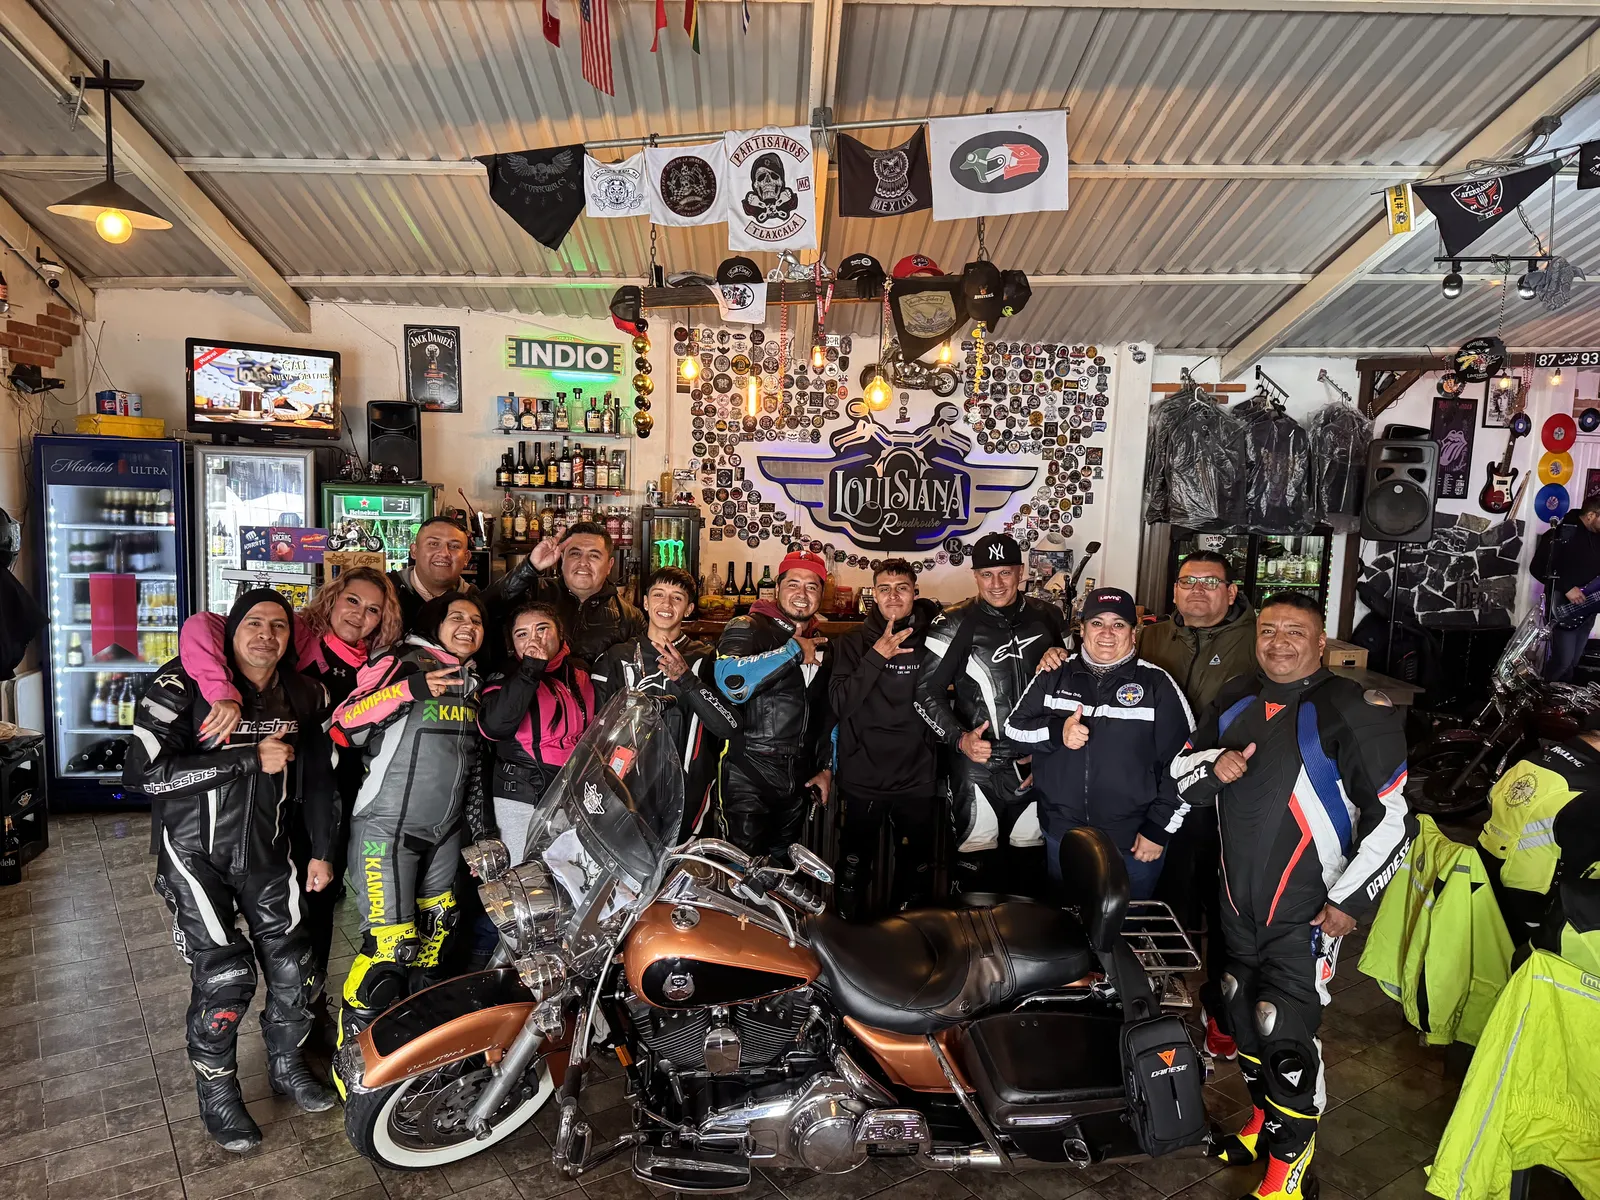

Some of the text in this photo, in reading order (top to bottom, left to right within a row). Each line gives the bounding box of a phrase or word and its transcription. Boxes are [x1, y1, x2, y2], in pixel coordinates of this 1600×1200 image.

[733, 135, 804, 164] PARTISANOS
[798, 178, 810, 189] MC
[872, 195, 915, 212] MEXICO
[752, 219, 800, 240] TLAXCALA
[410, 331, 455, 349] JACK DANIEL'S
[521, 341, 609, 370] INDIO
[1539, 353, 1557, 367] 87
[50, 457, 168, 476] Michelob ULTRA
[833, 468, 969, 526] LOUISIANA
[878, 511, 942, 536] Roadhouse
[987, 542, 1006, 561] NY
[343, 682, 405, 724] KAMPAK
[233, 717, 299, 735] inestars
[142, 766, 217, 795] alpinestars
[1366, 837, 1411, 902] DAINESE
[1150, 1063, 1188, 1078] DAINESE
